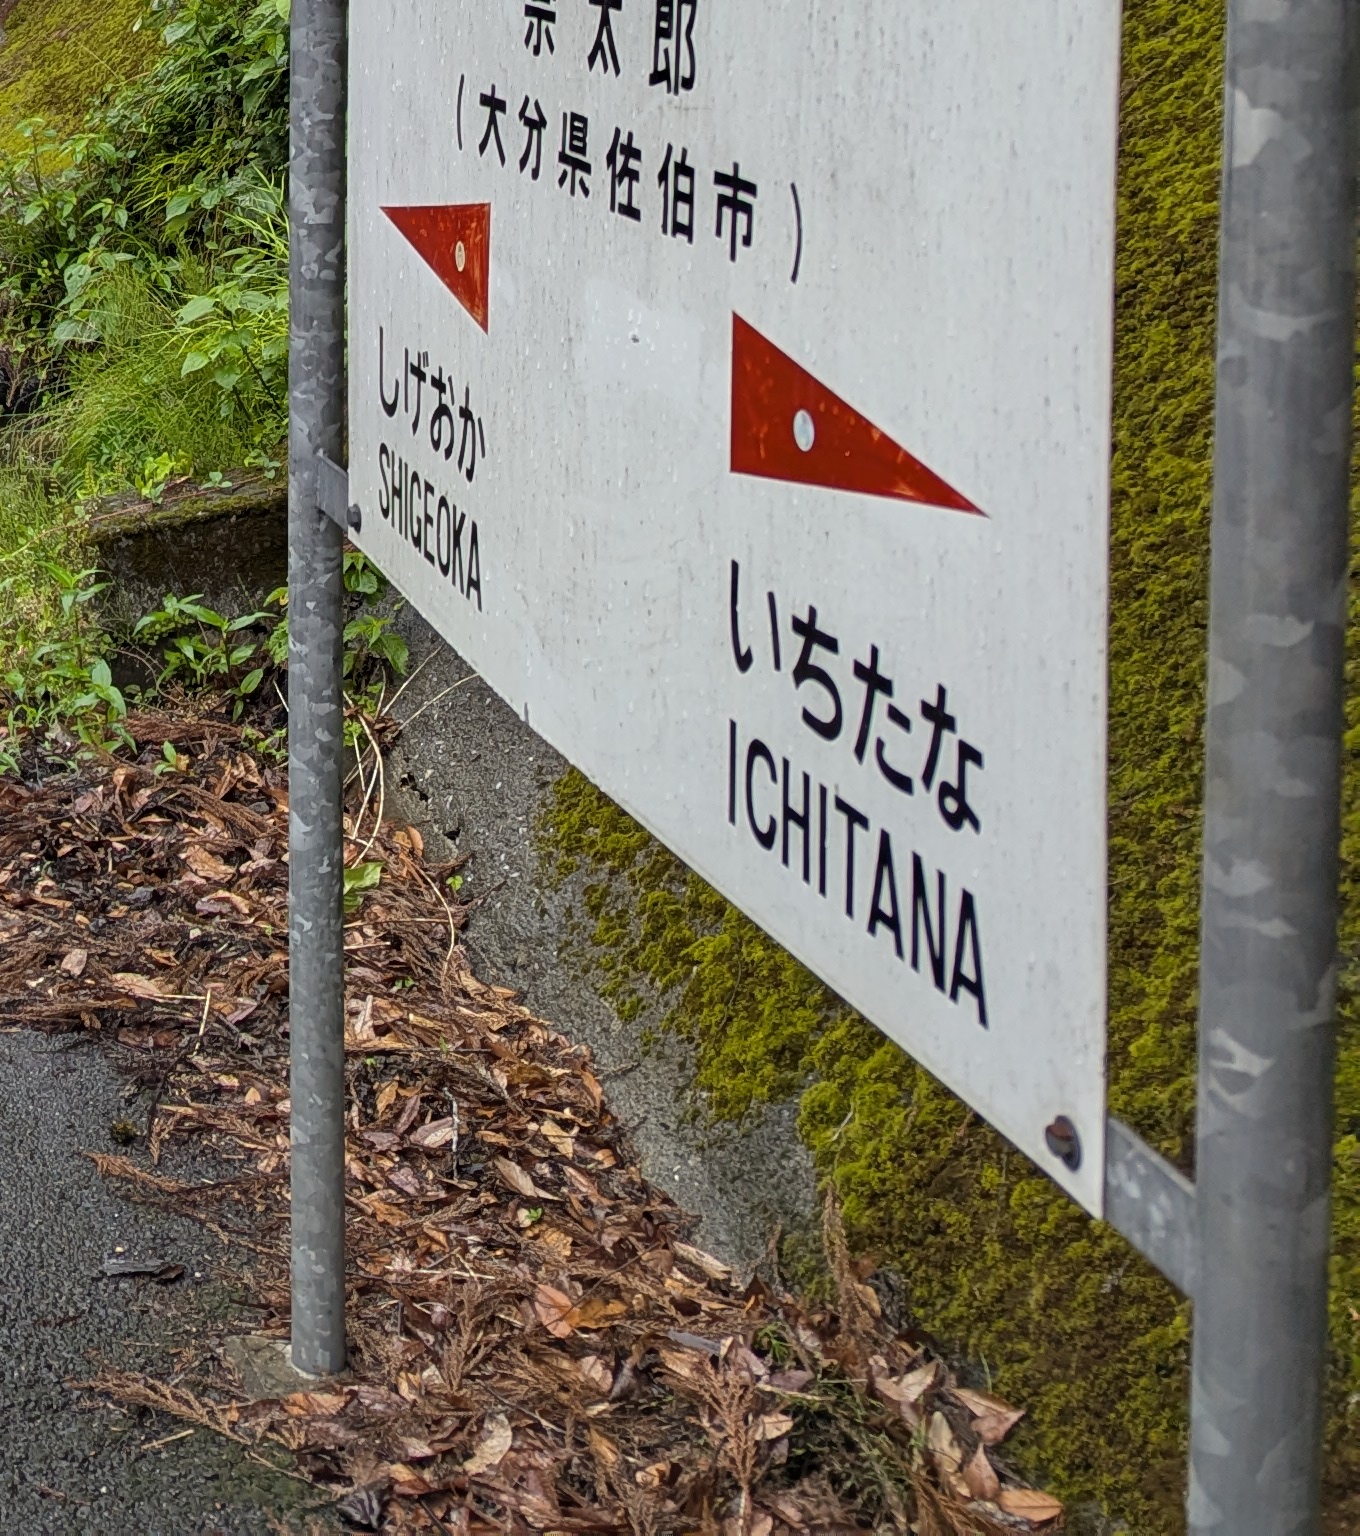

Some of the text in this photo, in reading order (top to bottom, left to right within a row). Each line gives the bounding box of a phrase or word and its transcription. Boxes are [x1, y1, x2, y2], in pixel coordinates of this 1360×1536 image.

[455, 74, 803, 283] （大分県佐伯市）
[378, 325, 486, 484] しげおか
[378, 441, 483, 614] SHIGEOKA
[728, 559, 985, 833] いちたな
[728, 718, 989, 1029] ICHITANA
